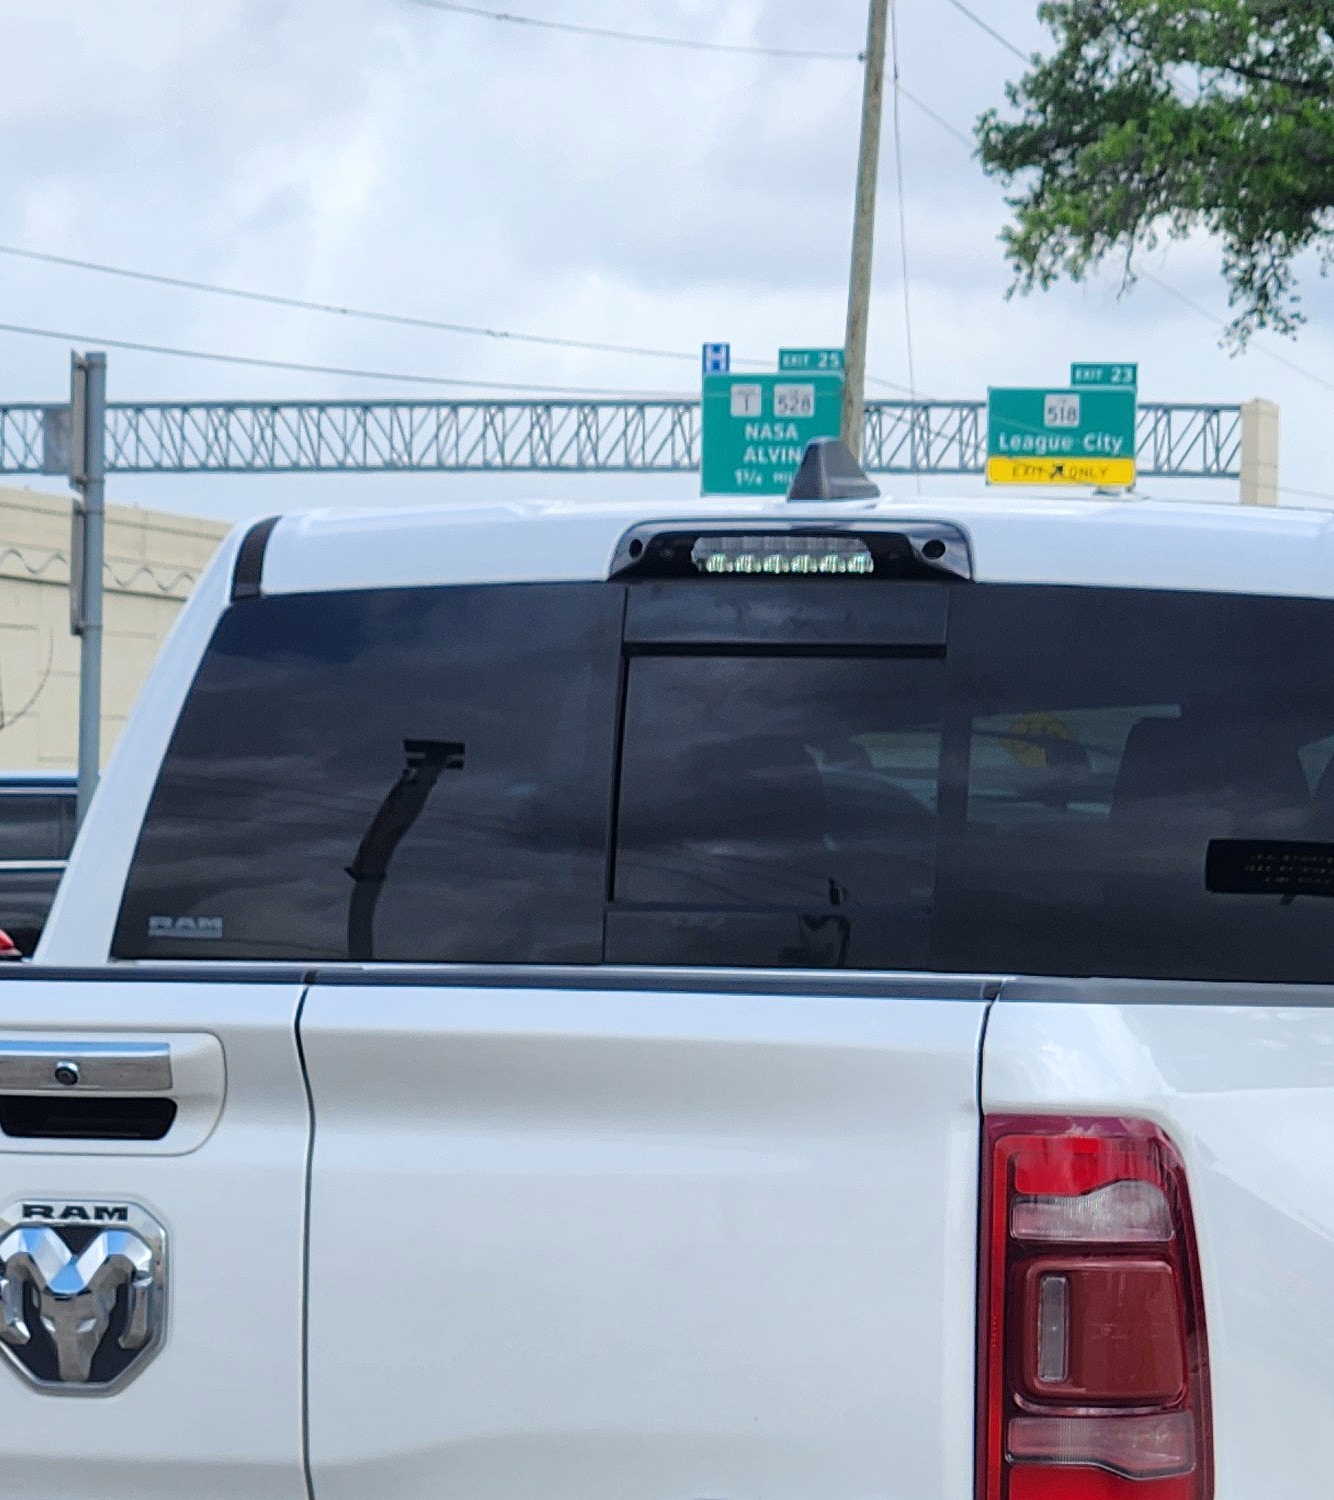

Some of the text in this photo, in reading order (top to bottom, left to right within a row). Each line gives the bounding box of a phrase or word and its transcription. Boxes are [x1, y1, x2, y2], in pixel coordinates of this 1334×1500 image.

[706, 344, 727, 372] H
[783, 351, 839, 368] EXIT 25
[1075, 367, 1133, 382] EXIT 23
[1047, 404, 1078, 423] 518
[745, 423, 798, 441] NASA
[999, 432, 1124, 455] League City
[744, 446, 802, 464] ALVIN
[21, 1203, 129, 1221] RAM
